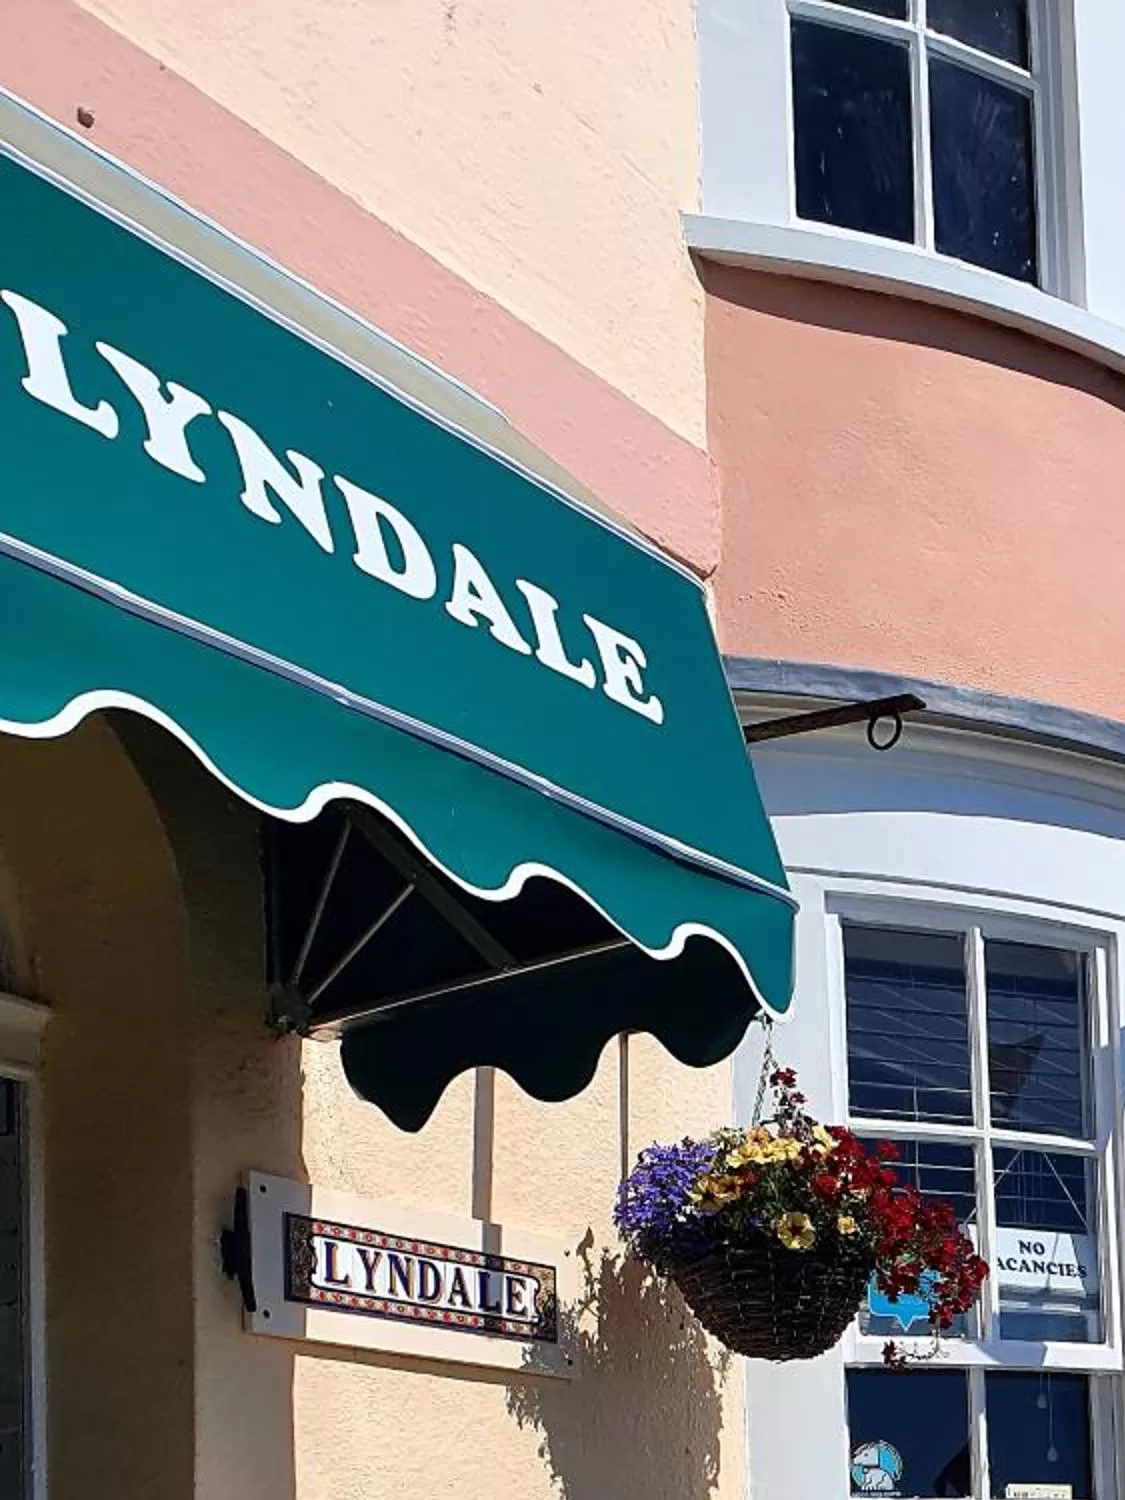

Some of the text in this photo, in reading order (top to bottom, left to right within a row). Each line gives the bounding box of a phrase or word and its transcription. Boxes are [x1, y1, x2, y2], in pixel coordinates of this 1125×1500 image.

[1, 289, 663, 725] LYNDALE
[997, 1257, 1087, 1278] ACANCIES
[1018, 1240, 1045, 1255] NO
[324, 1241, 528, 1316] LYNDALE
